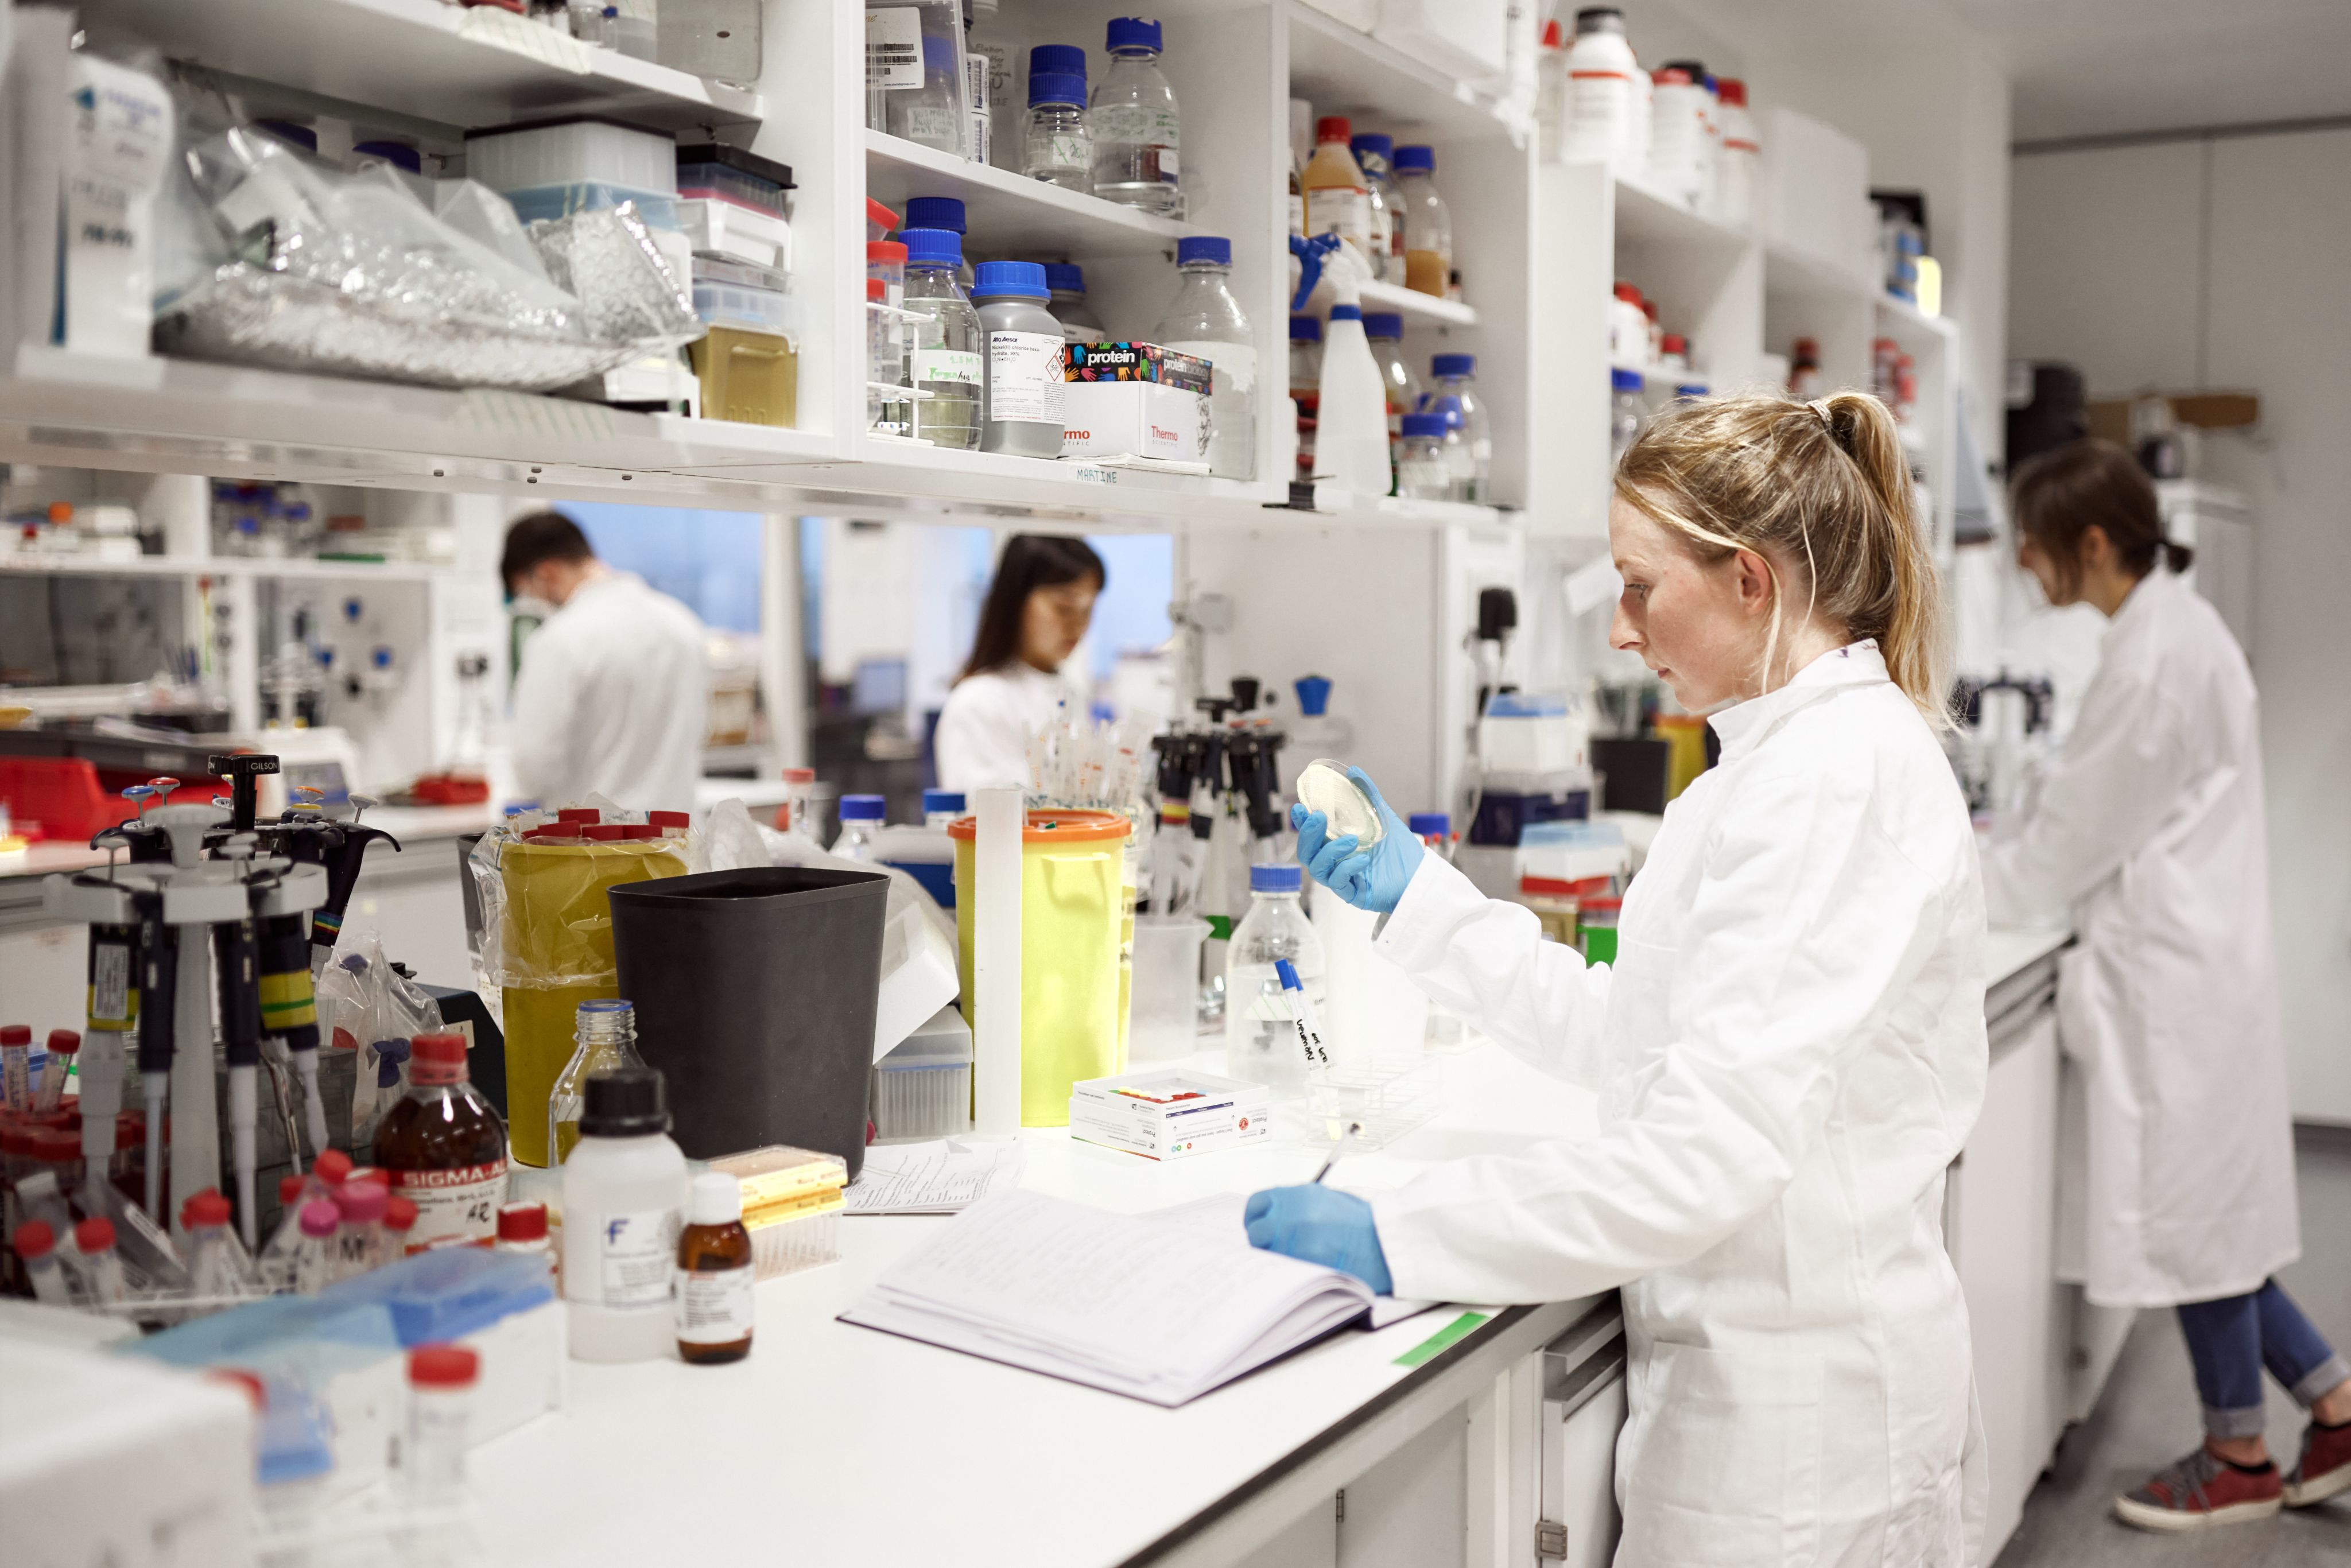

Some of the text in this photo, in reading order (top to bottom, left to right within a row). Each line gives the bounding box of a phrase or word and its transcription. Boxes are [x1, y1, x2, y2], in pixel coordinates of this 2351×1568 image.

[1088, 350, 1135, 366] protein
[1064, 430, 1090, 439] rmo
[1151, 425, 1178, 441] Thermo
[1077, 468, 1117, 483] MARTINE
[1142, 1129, 1156, 1138] Protect
